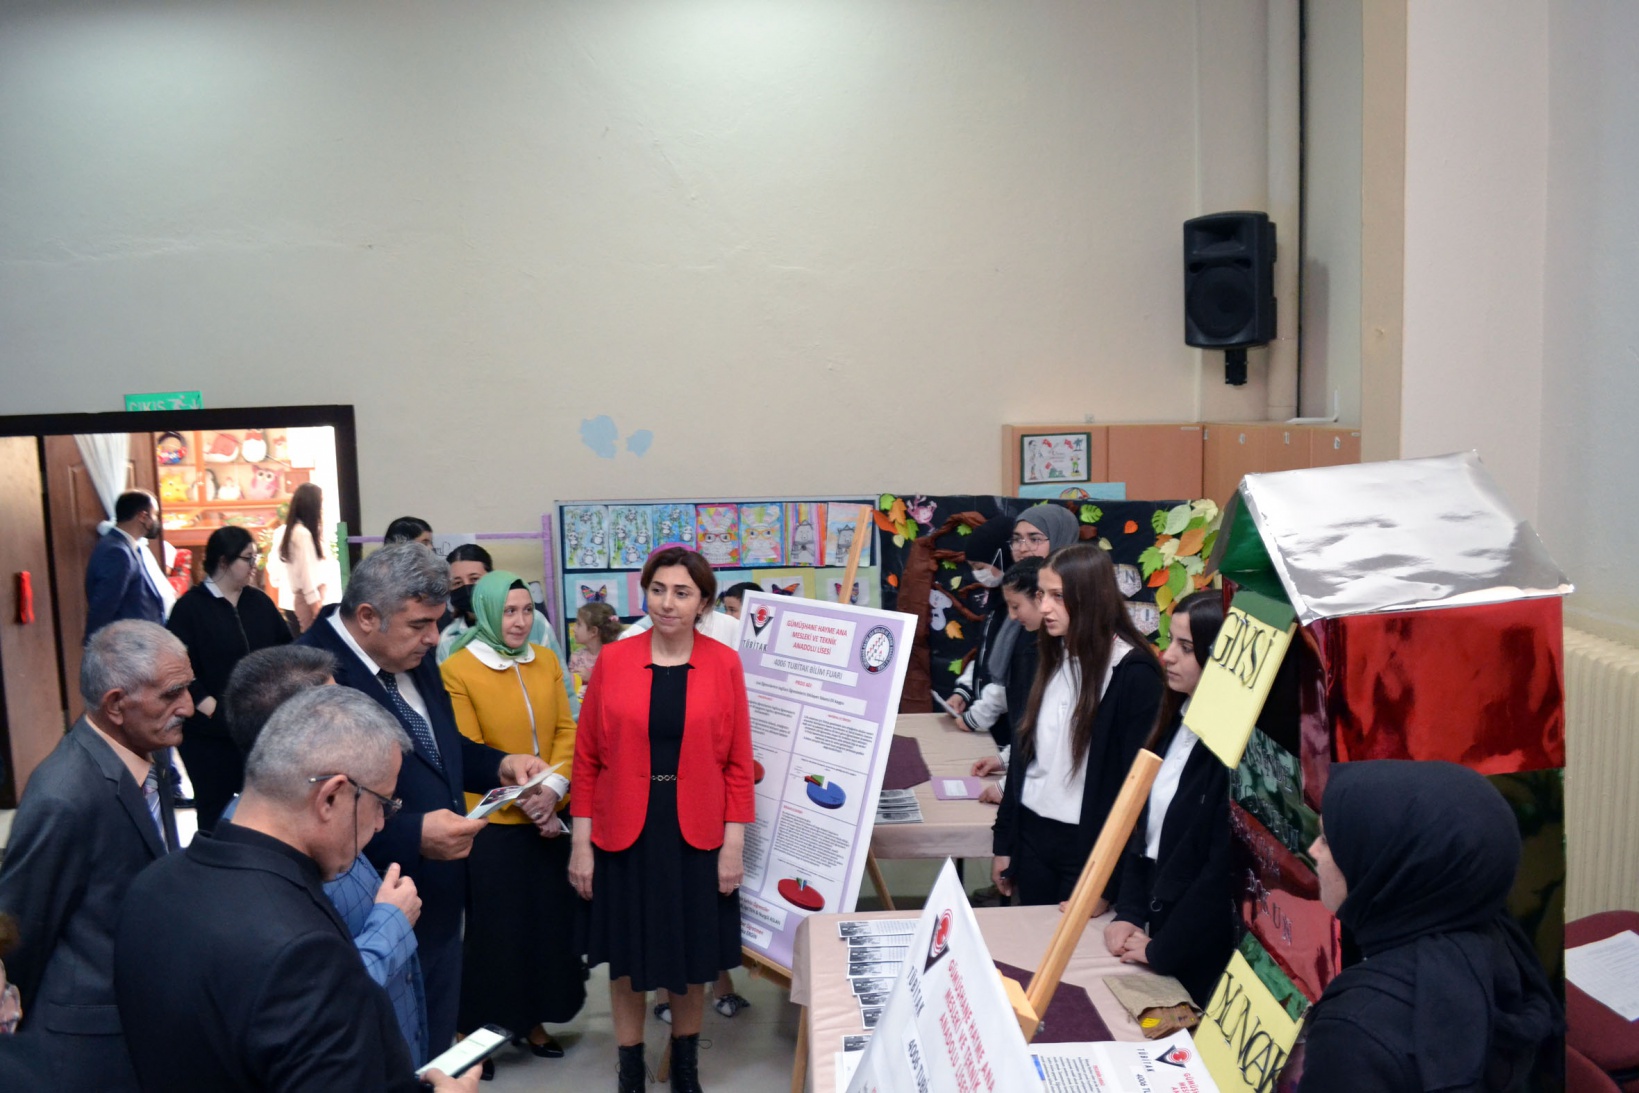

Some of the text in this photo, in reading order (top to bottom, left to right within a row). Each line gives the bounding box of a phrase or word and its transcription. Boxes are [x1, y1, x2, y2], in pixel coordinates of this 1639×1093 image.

[786, 619, 818, 631] GÜMÜŞHANE
[836, 628, 848, 637] ANA
[812, 634, 819, 642] VE
[792, 642, 817, 652] ANADOLU
[981, 1060, 995, 1093] ANA
